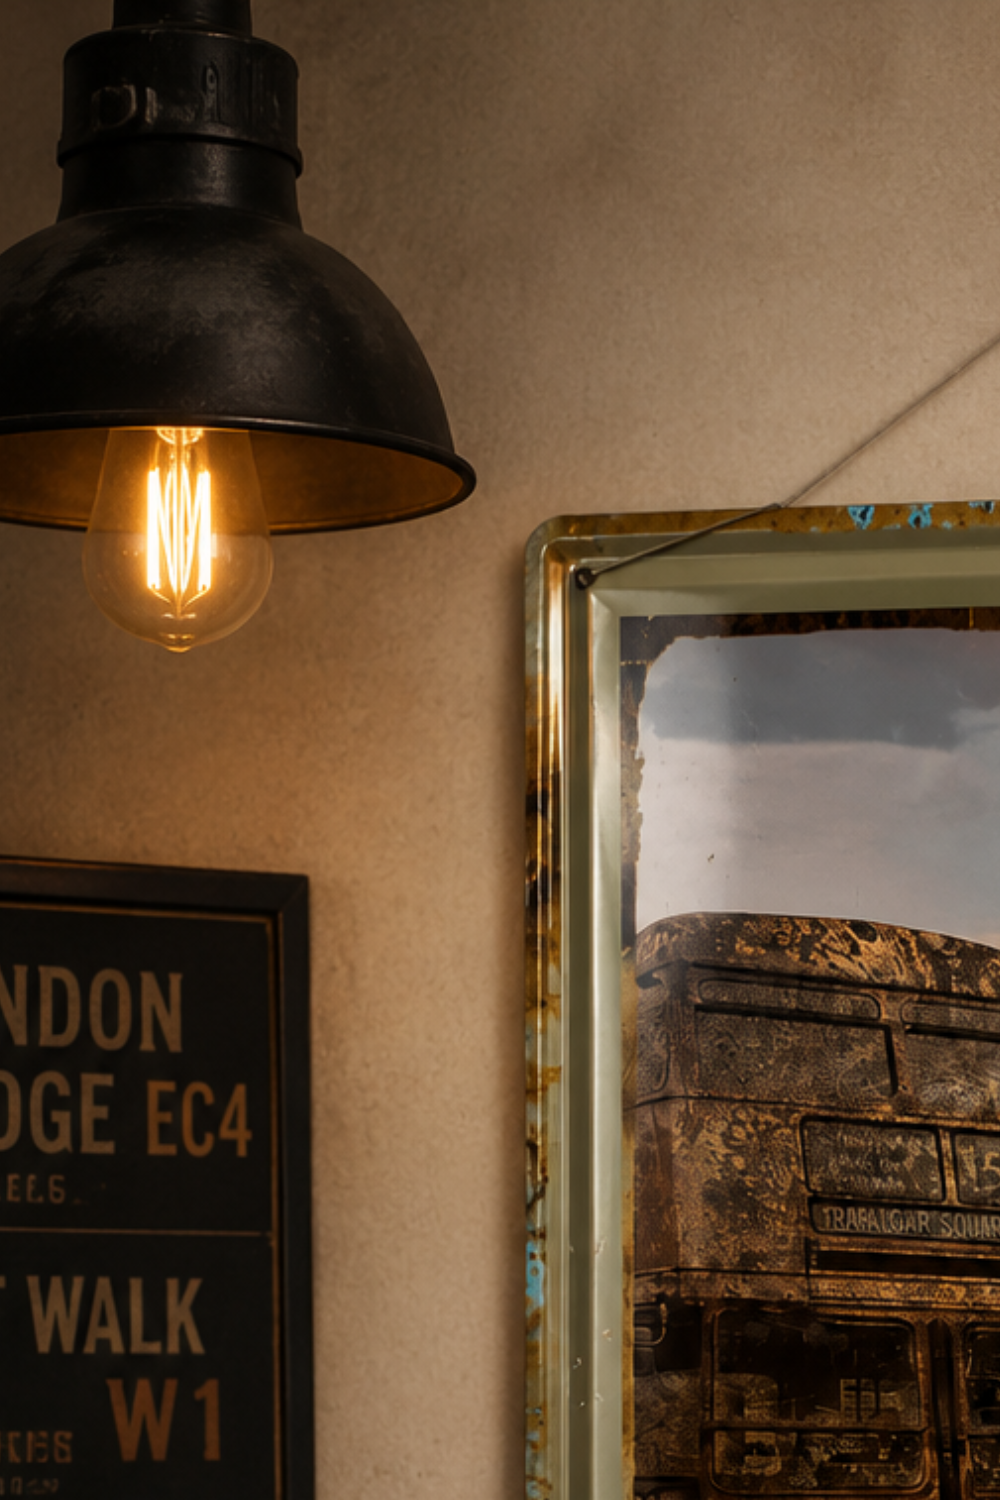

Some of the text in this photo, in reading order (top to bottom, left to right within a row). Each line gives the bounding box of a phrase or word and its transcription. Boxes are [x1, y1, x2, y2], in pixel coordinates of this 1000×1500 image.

[146, 1079, 253, 1159] EC4
[821, 1205, 932, 1236] TRAFALGAR
[26, 1274, 206, 1356] WALK
